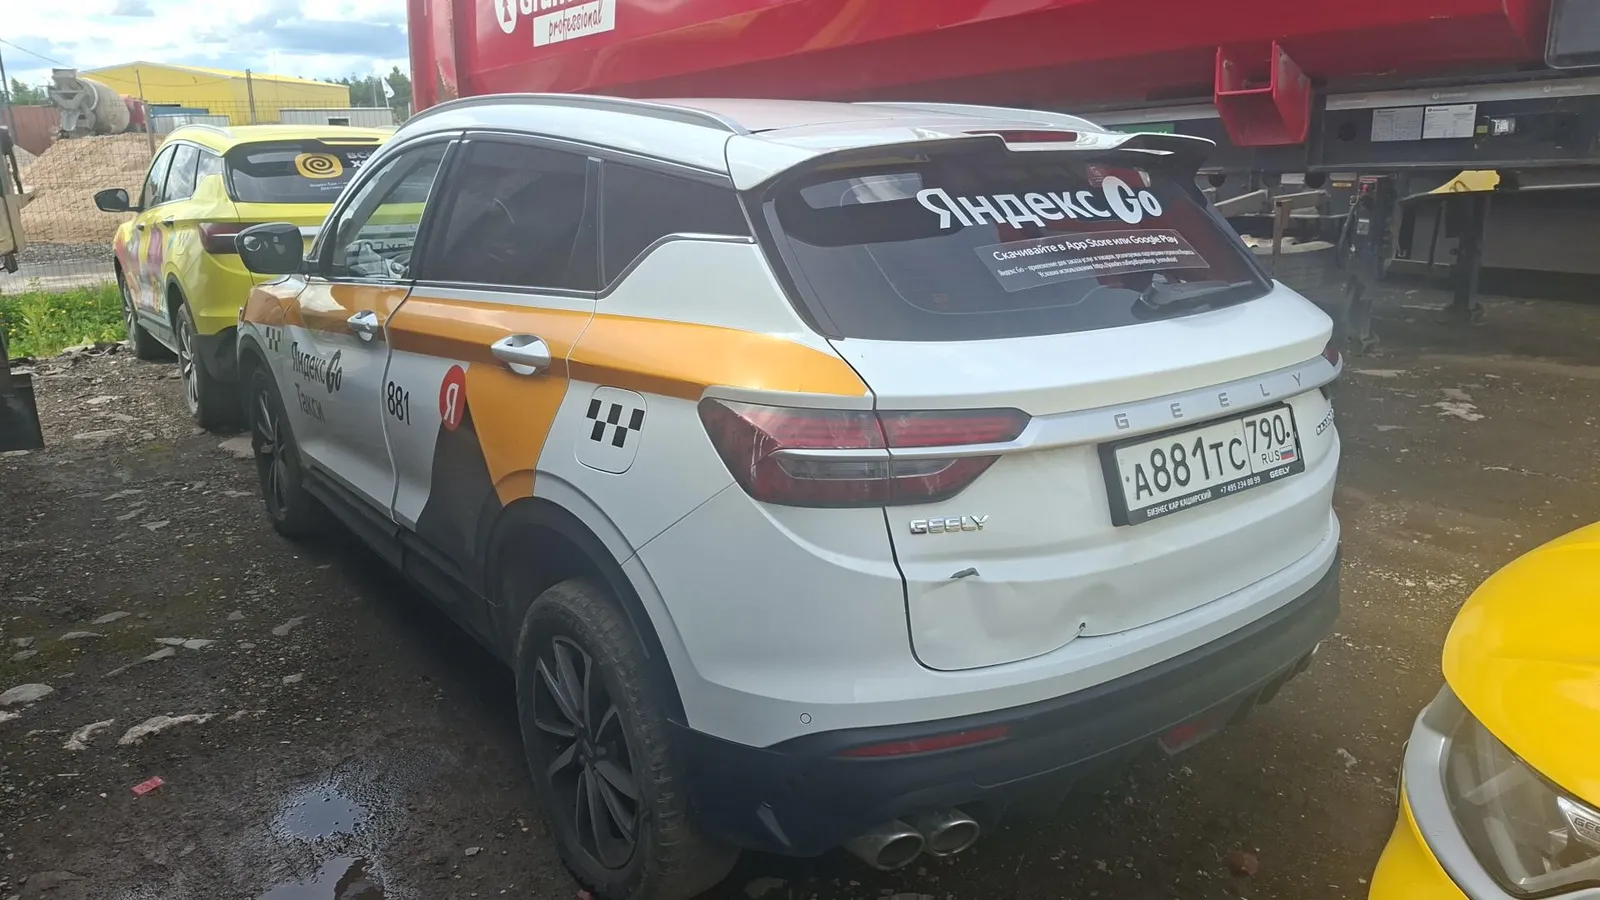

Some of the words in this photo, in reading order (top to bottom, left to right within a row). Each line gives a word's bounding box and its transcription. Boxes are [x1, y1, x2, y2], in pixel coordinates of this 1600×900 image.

[548, 0, 604, 44] professional
[916, 188, 1111, 229] Яндекс
[1102, 176, 1162, 224] Go
[993, 244, 1059, 261] Скачивайте
[1065, 240, 1088, 251] App
[1086, 238, 1114, 248] Store
[1113, 237, 1131, 246] или
[1129, 235, 1161, 245] Google
[1158, 234, 1179, 245] Play
[291, 341, 327, 384] Яндекс
[326, 349, 343, 394] Go
[294, 382, 326, 426] Такси
[387, 380, 411, 426] 881
[443, 382, 460, 425] Я
[1114, 372, 1305, 430] GEELY
[1246, 414, 1286, 453] 790
[1261, 450, 1281, 465] RUS
[1269, 466, 1290, 479] GEELY
[1147, 505, 1168, 517] БИЗНЕС
[1168, 500, 1180, 511] КАР
[1179, 489, 1212, 507] КАШИРСКИЙ
[1227, 482, 1237, 492] 495
[1237, 479, 1247, 489] 234
[909, 514, 989, 534] GEELY
